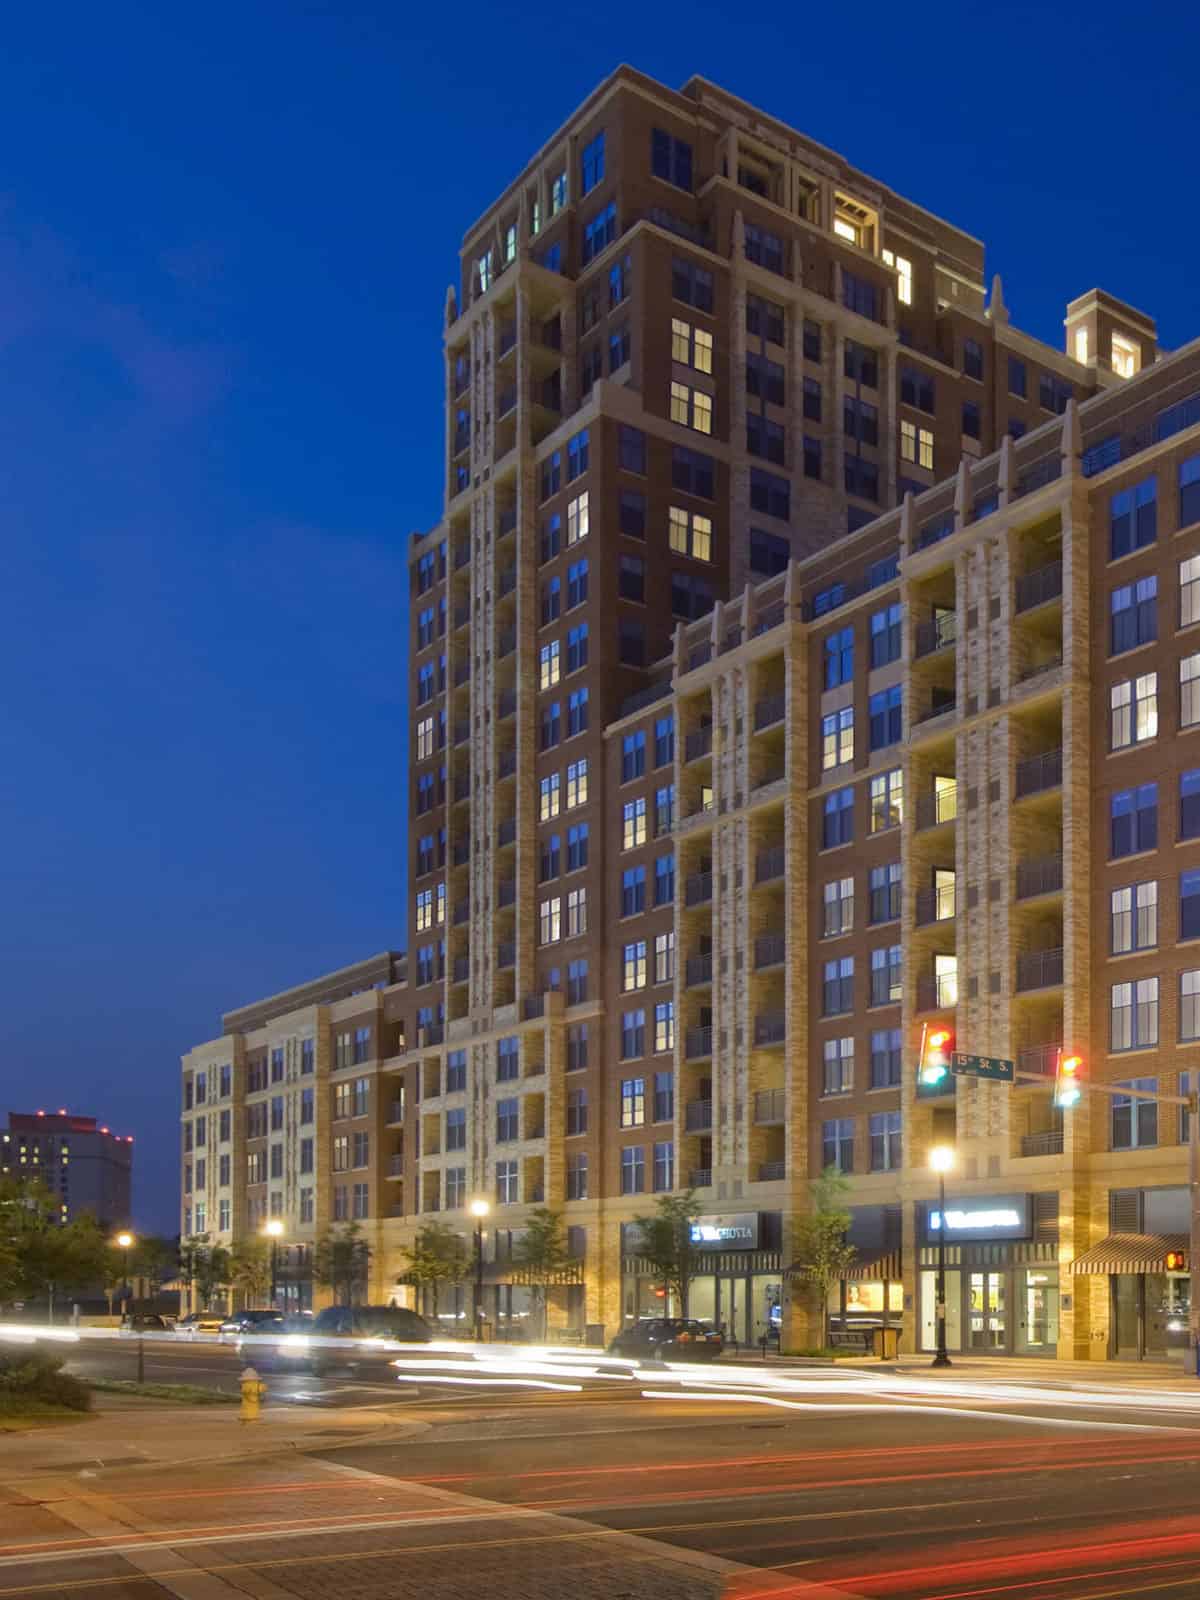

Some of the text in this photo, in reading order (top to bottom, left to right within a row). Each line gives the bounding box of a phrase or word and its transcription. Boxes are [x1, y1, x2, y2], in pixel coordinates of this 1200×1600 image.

[958, 1055, 976, 1066] 15
[1000, 1061, 1009, 1072] S.
[701, 1226, 753, 1240] CHOVIA
